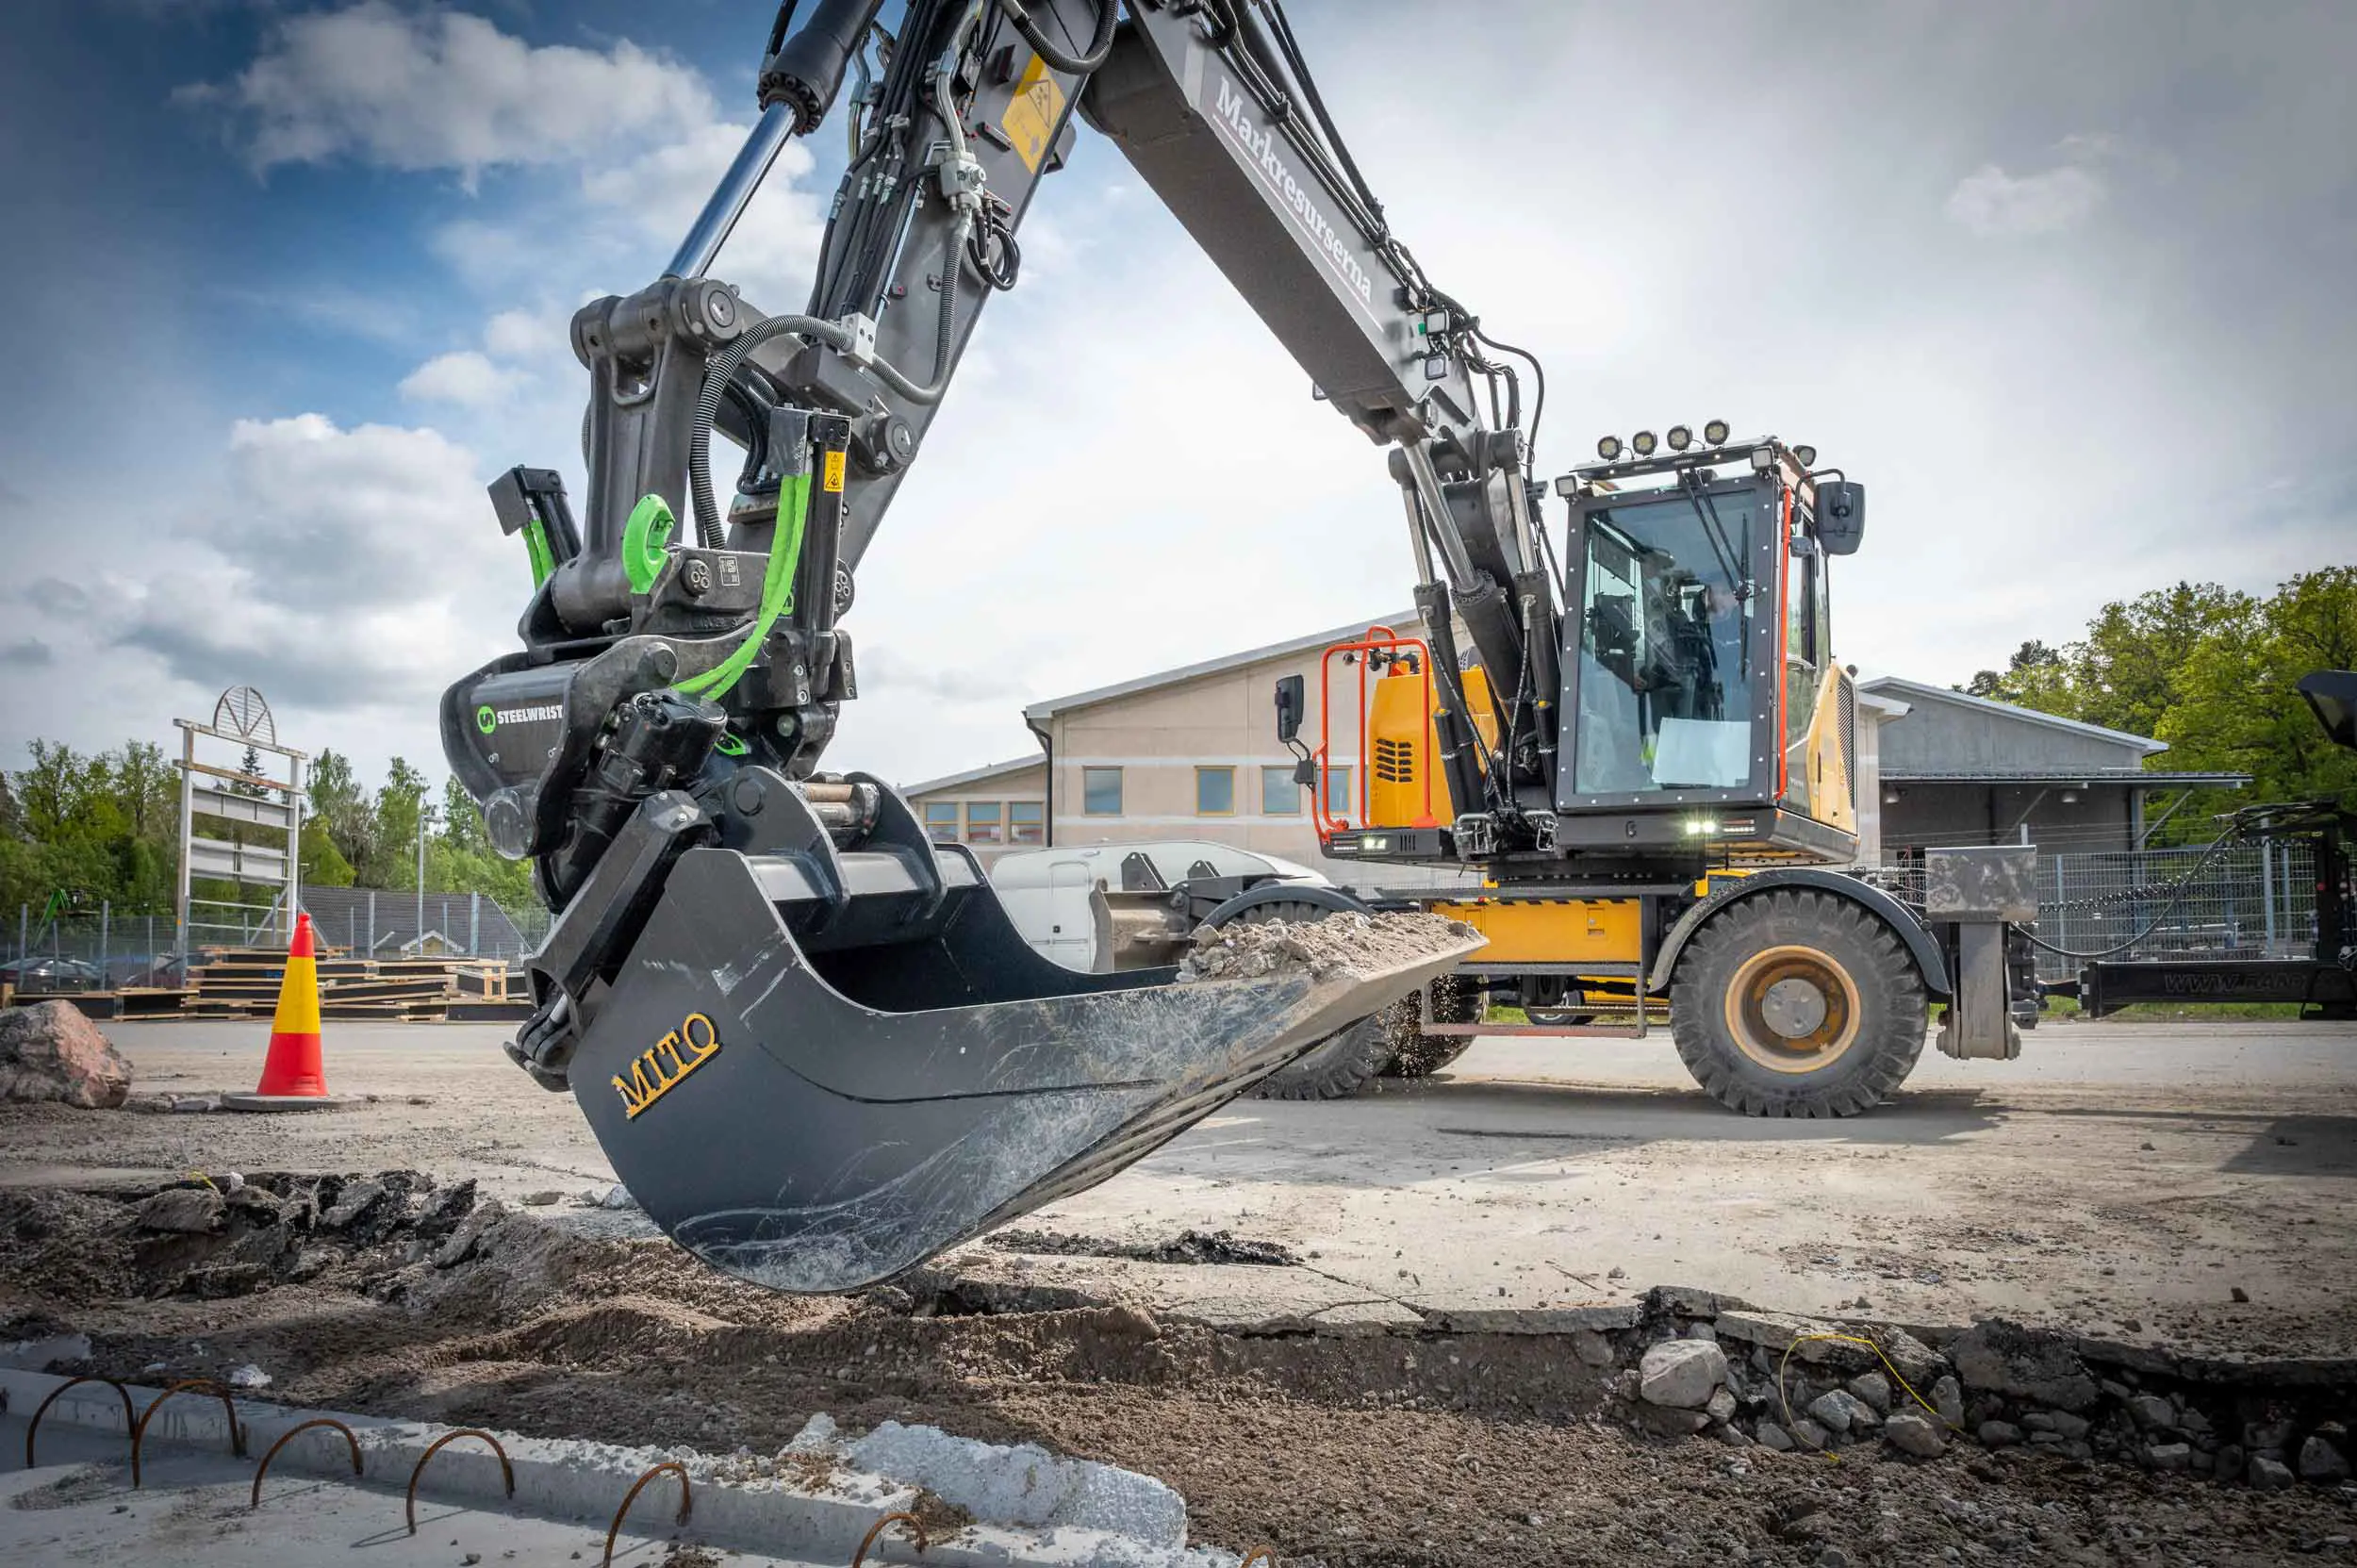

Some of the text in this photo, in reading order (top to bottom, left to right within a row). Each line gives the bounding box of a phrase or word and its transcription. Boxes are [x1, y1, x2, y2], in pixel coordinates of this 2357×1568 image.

[1216, 75, 1372, 302] Markresurserna
[497, 704, 563, 724] STEELWRIST
[611, 1013, 717, 1116] MITO
